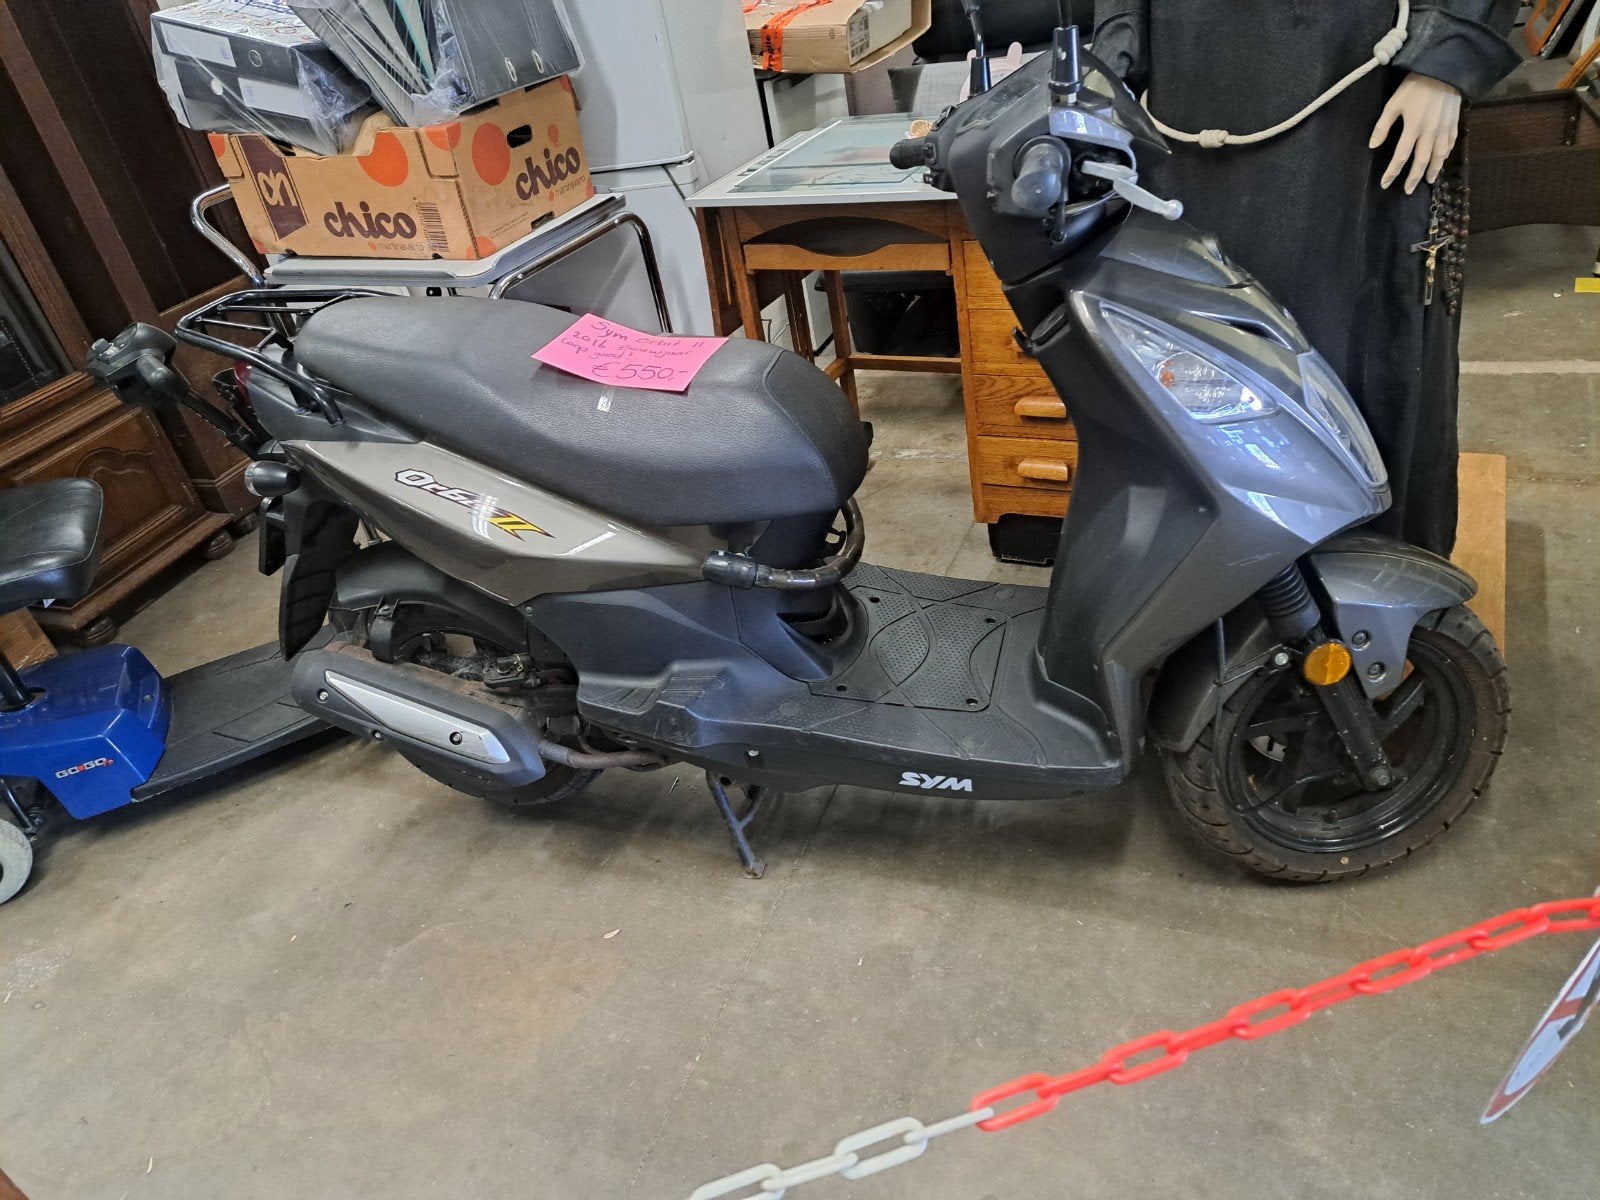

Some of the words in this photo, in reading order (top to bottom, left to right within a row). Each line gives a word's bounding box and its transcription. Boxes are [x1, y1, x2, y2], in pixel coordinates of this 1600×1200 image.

[516, 147, 581, 201] chico
[323, 201, 418, 239] chico
[572, 331, 608, 349] 2016
[590, 321, 628, 341] Sym
[898, 771, 973, 792] SYM
